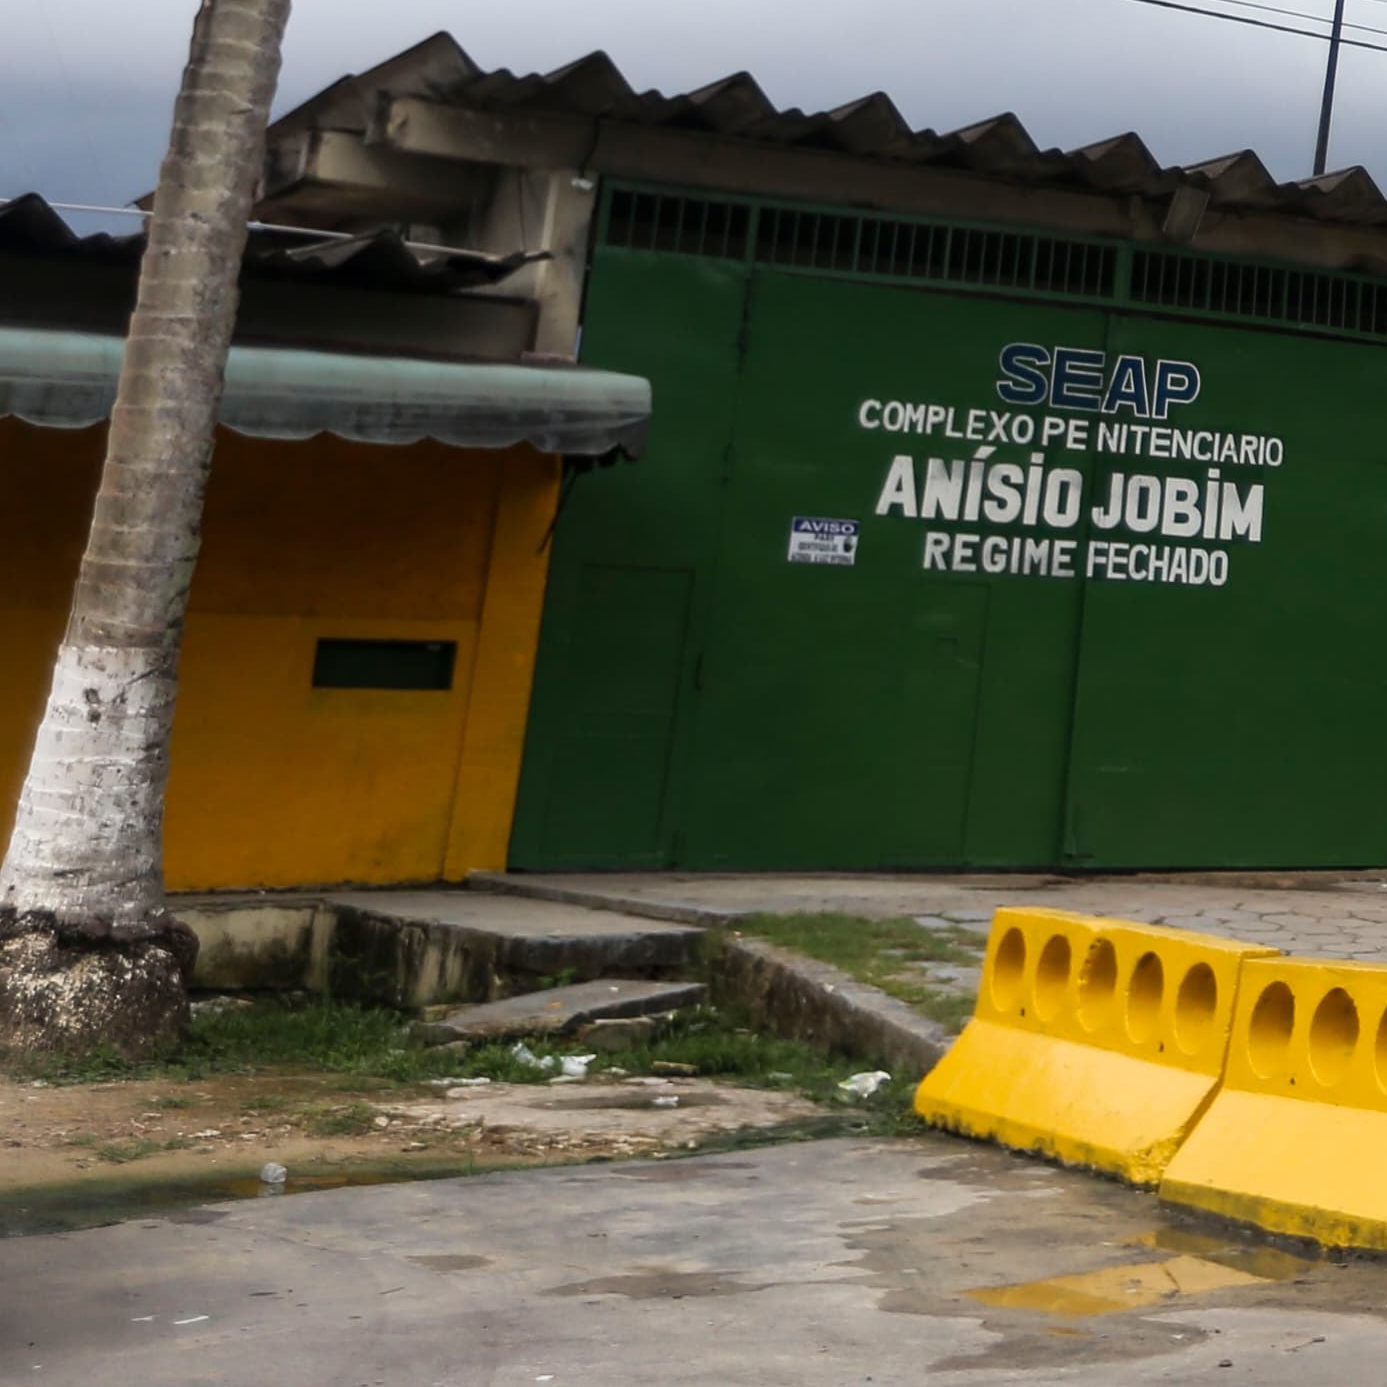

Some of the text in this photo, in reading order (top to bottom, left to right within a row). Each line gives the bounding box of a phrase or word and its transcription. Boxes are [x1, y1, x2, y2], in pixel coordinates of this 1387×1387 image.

[996, 342, 1201, 419] SEAP
[858, 398, 1034, 445] COMPLEXO
[799, 520, 855, 534] AVISO
[922, 531, 1229, 587] REGIME FECHADO
